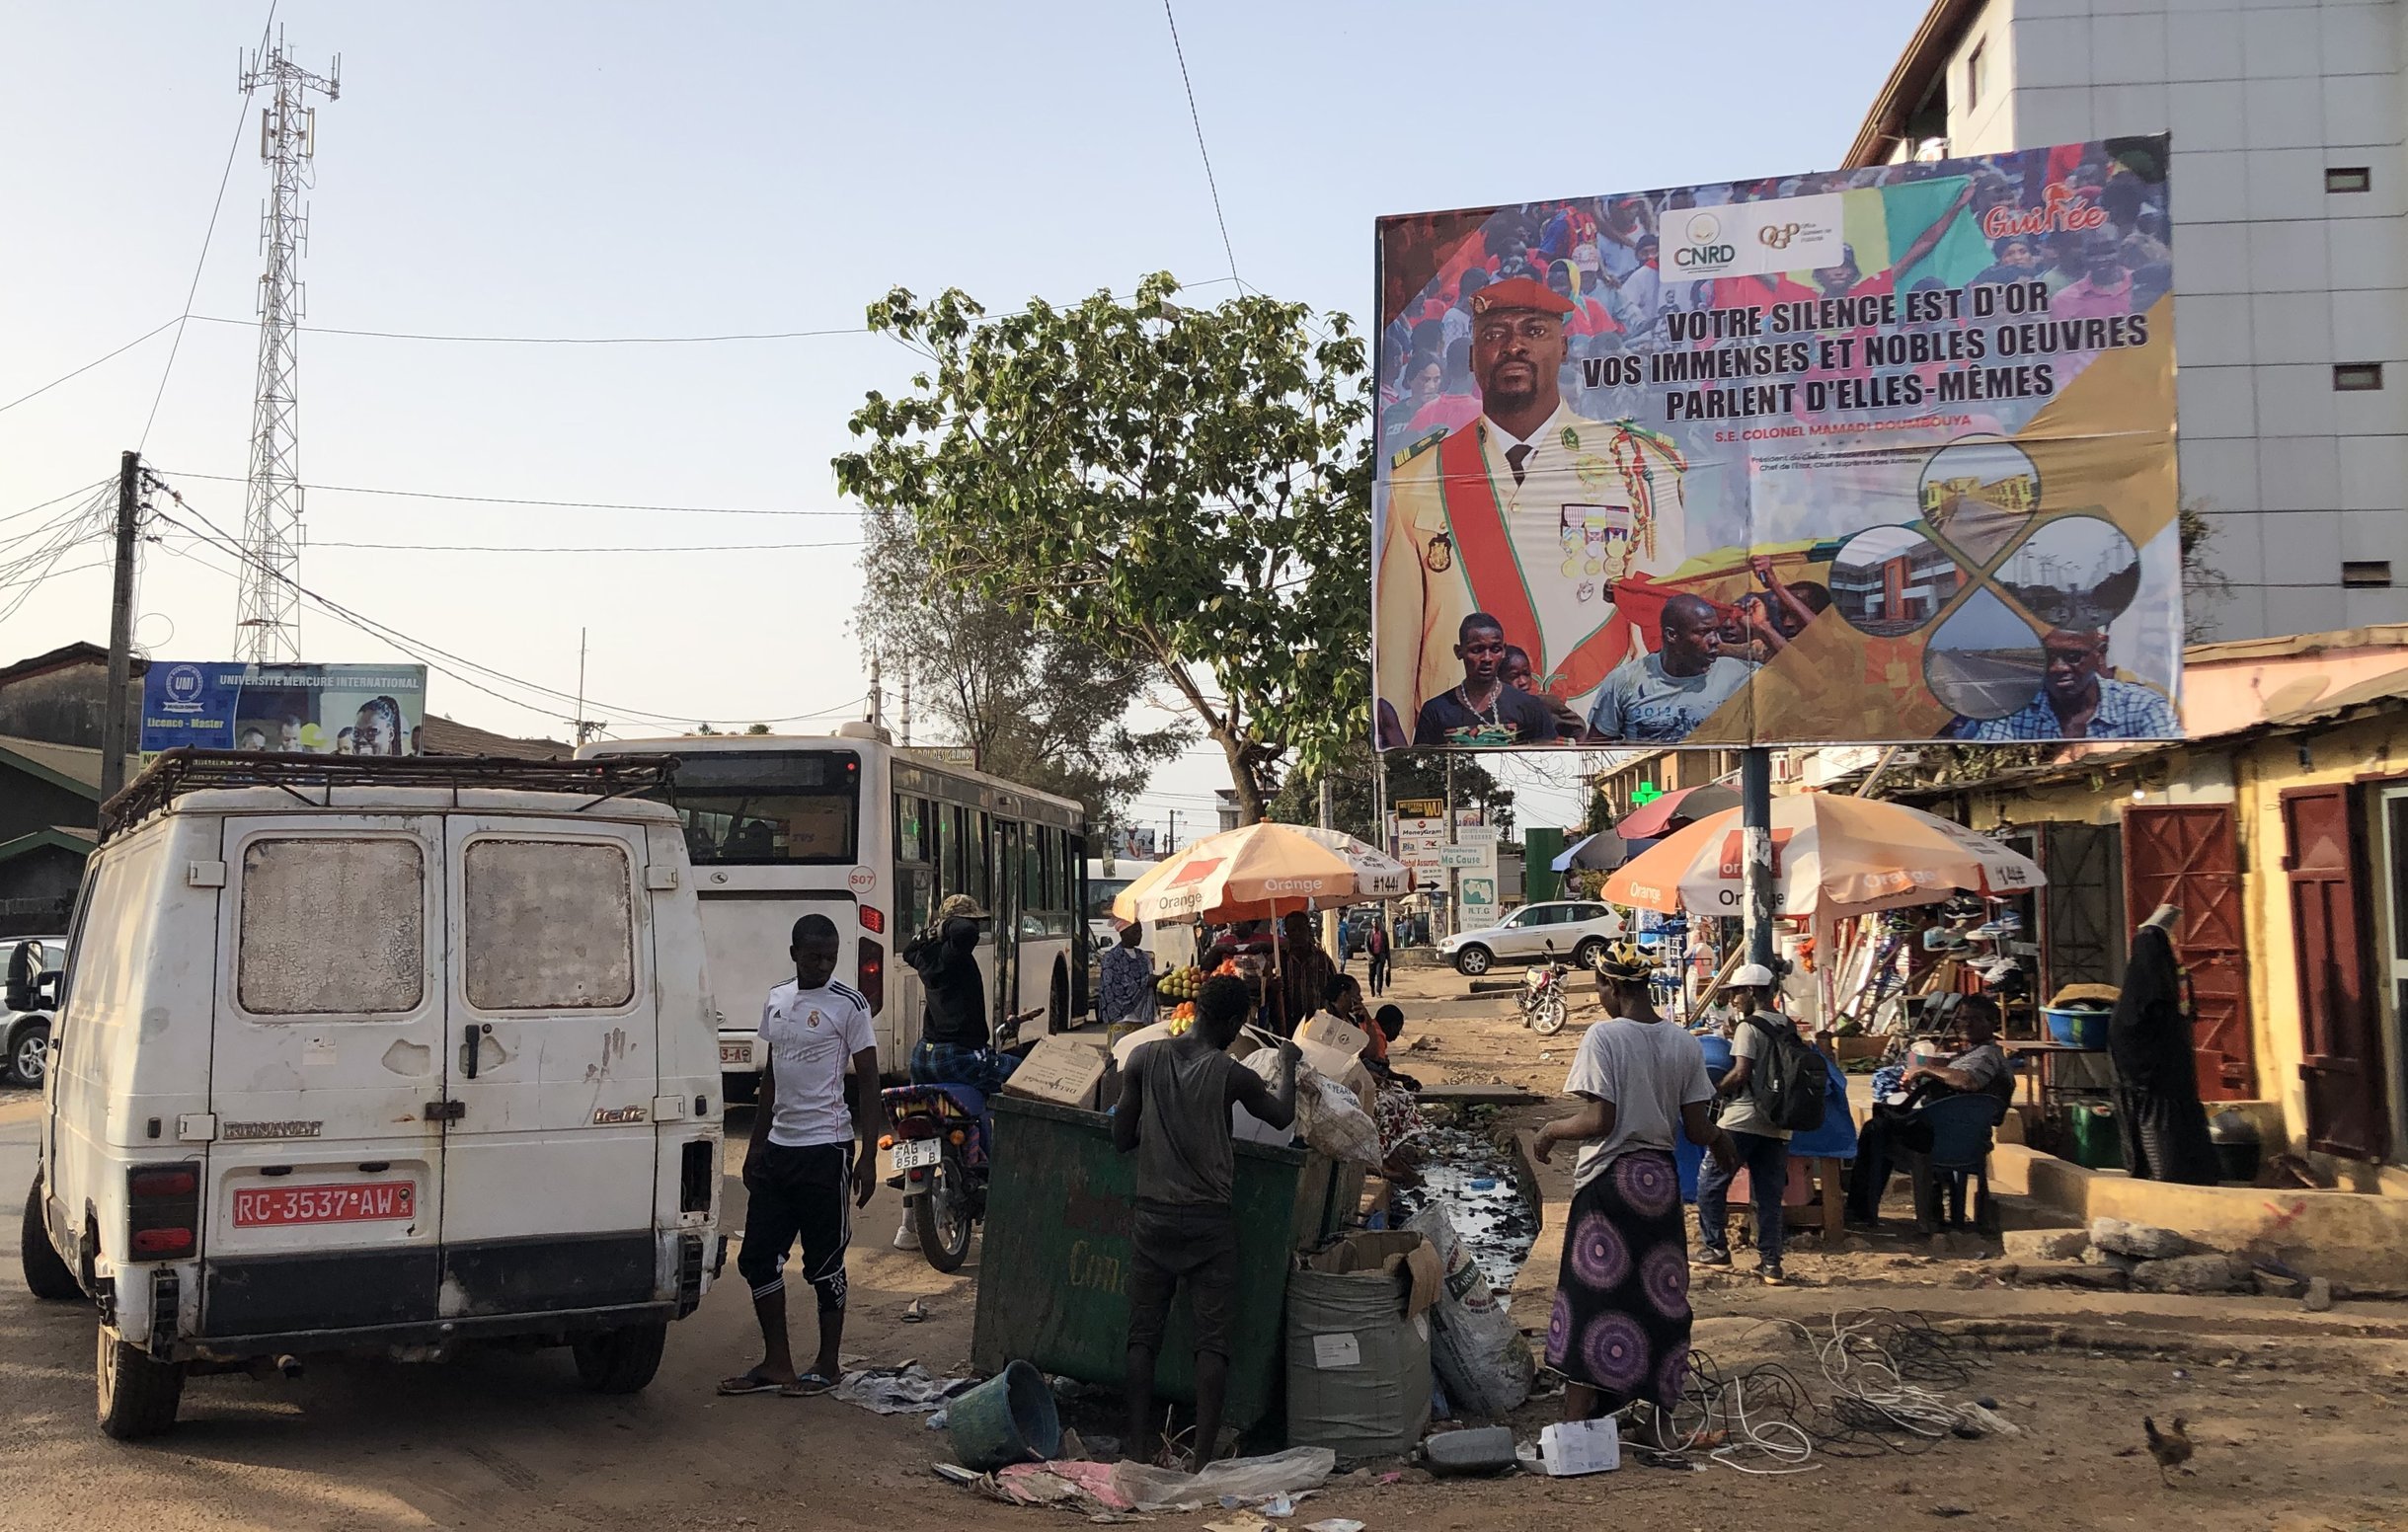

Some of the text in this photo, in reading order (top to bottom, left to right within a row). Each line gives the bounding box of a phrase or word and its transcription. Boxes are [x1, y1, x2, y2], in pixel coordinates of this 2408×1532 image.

[1983, 184, 2109, 239] Guinée
[1674, 244, 1736, 267] CNRD
[1666, 281, 2050, 344] VOTRE SILENCE EST D'OR
[1582, 314, 2148, 389] VOS IMMENSES ET NOBLES OEUVRES
[1665, 363, 2055, 421] PARLENT D'ELLES-MÊMES
[1715, 431, 1739, 442] S.E.
[1743, 426, 1806, 441] COLONEL
[1809, 422, 1870, 436] MAMADI
[175, 676, 194, 691] UMI
[219, 674, 420, 689] UNIVERSITE MERCURE INTERNATIONAL
[147, 718, 184, 728] Licence
[191, 719, 224, 728] Master
[947, 749, 973, 761] GRANDS
[1424, 802, 1441, 816] WU
[1441, 855, 1481, 865] Ma Cause
[850, 875, 874, 884] S07
[1264, 878, 1323, 892] Orange
[1159, 892, 1203, 909] Orange
[1630, 881, 1662, 904] Orange
[1719, 889, 1785, 909] Ore
[903, 1142, 918, 1156] AG
[896, 1151, 936, 1169] 858 B
